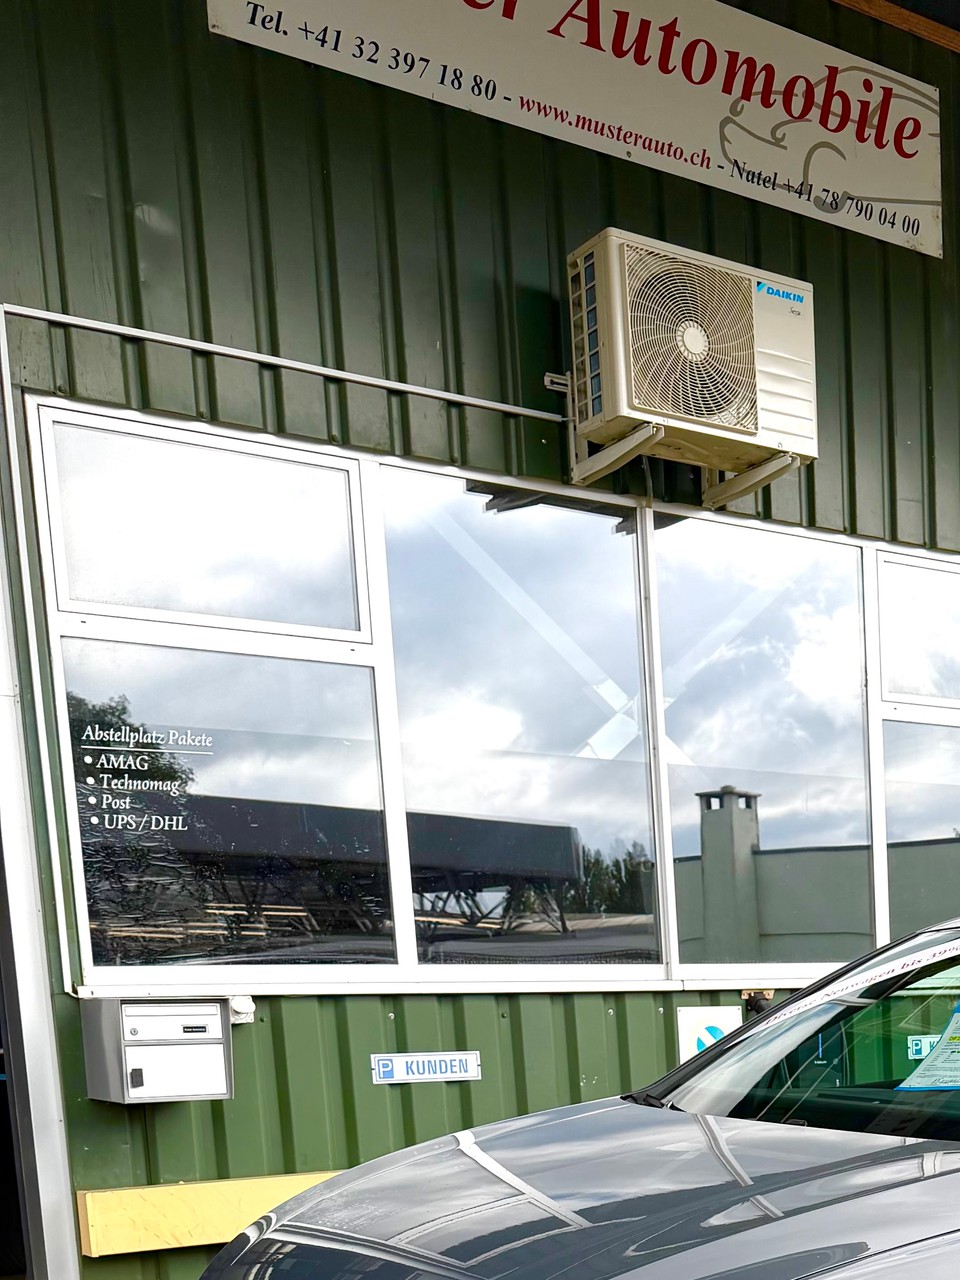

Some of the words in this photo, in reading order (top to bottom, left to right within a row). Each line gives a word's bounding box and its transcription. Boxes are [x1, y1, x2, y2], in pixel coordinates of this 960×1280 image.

[547, 0, 921, 159] Automobile
[246, 1, 289, 36] Tel.
[298, 21, 342, 53] +41
[352, 36, 380, 64] 32
[388, 48, 430, 78] 397
[437, 64, 463, 90] 18
[471, 74, 497, 101] 80
[519, 95, 711, 170] www.musterauto.ch
[730, 159, 778, 191] Natel
[783, 178, 814, 202] +41
[821, 188, 840, 210] 78
[846, 196, 873, 221] 790
[879, 207, 896, 228] 04
[902, 214, 920, 236] 00
[766, 286, 804, 303] DAIKIN
[81, 725, 165, 748] Abstellplatz
[168, 730, 213, 747] Pakete
[96, 755, 149, 770] AMAG
[100, 774, 182, 797] Technomag
[101, 794, 131, 809] Post
[901, 959, 922, 970] bis
[379, 1060, 393, 1078] P
[405, 1058, 469, 1076] KUNDEN
